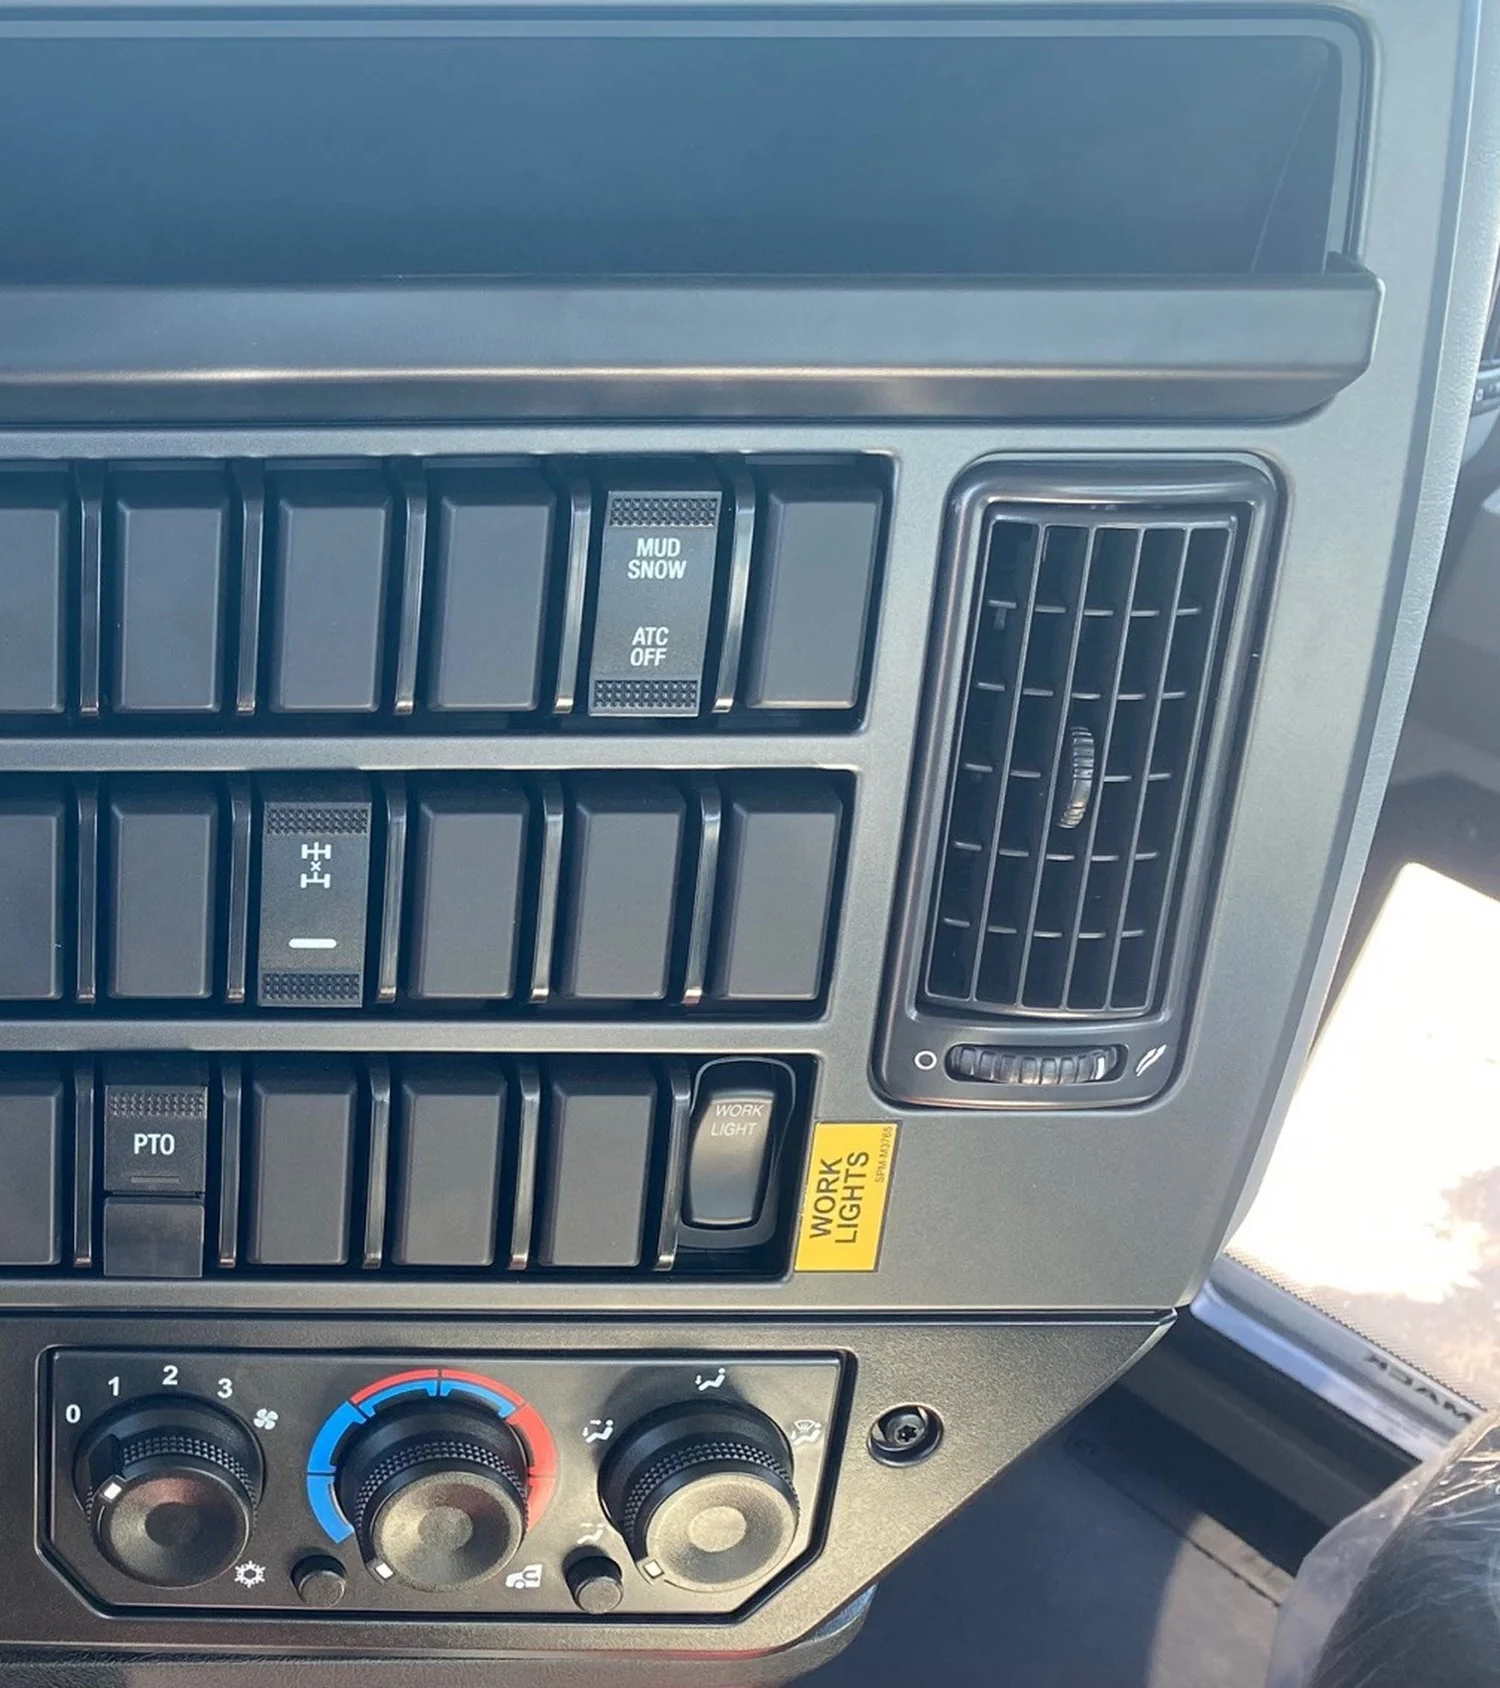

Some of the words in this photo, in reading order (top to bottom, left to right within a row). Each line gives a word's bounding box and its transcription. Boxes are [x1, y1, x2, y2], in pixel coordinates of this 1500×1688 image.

[636, 538, 681, 557] MUD
[627, 560, 687, 579] SNOW
[632, 626, 670, 646] ATC
[630, 648, 667, 666] OFF
[715, 1104, 765, 1117] WORK
[710, 1123, 758, 1137] LIGHT
[133, 1133, 175, 1155] PTO
[809, 1158, 843, 1239] WORK
[834, 1151, 869, 1244] LIGHTS
[162, 1365, 178, 1385] 2
[108, 1376, 120, 1396] 1
[217, 1378, 233, 1399] 3
[66, 1404, 81, 1424] 0
